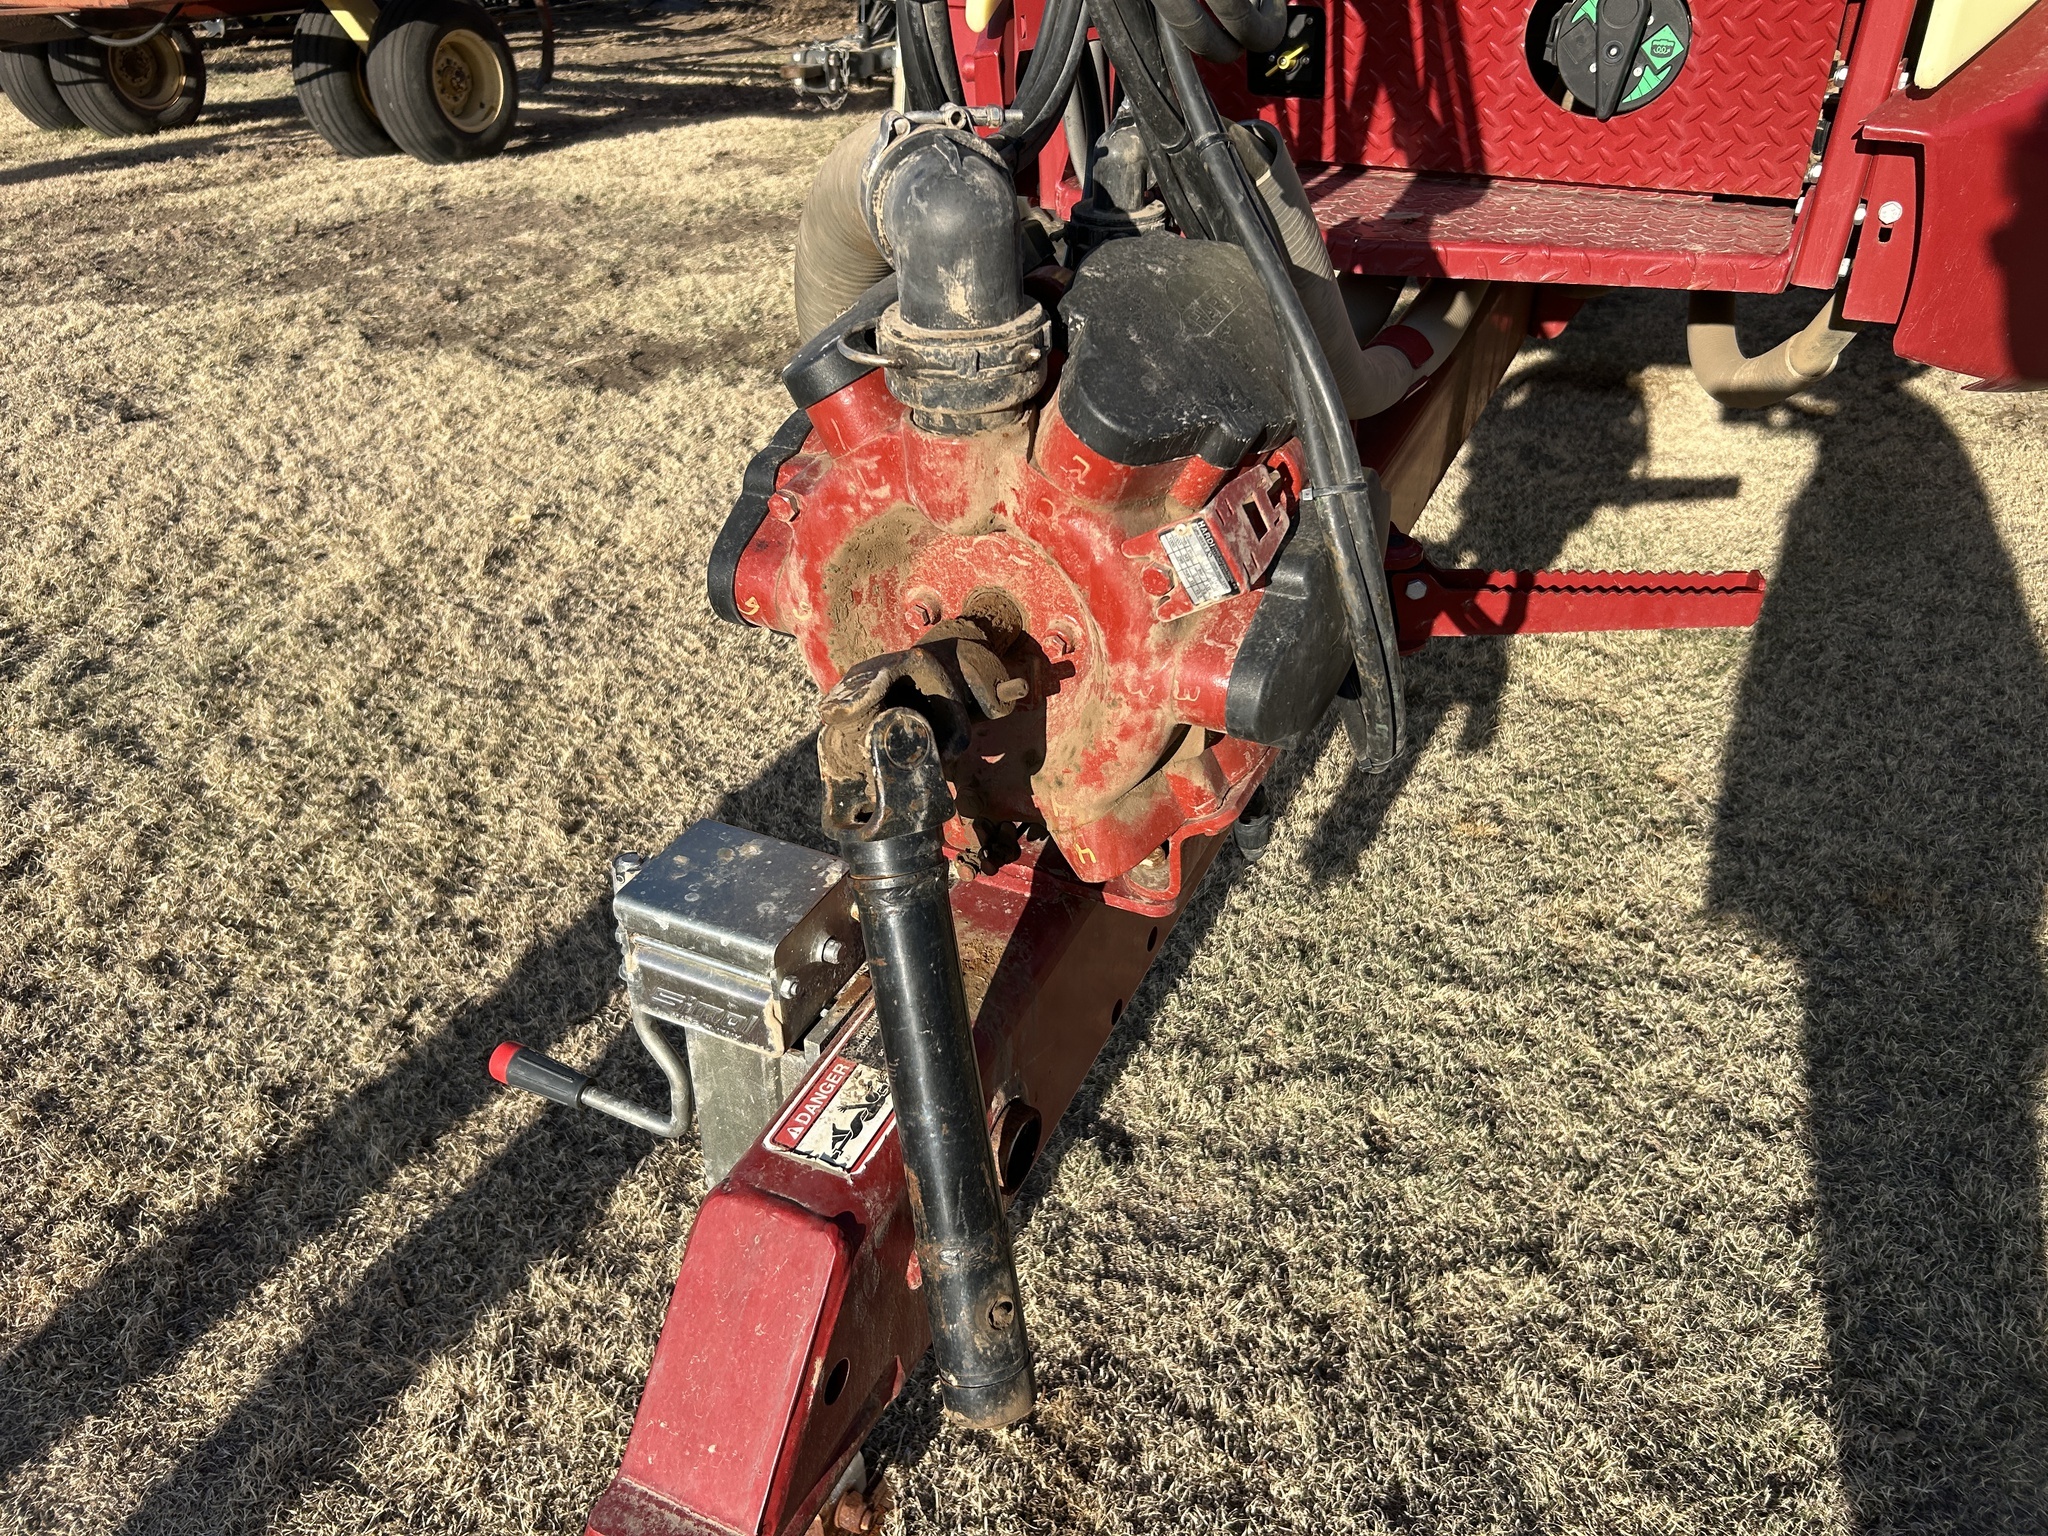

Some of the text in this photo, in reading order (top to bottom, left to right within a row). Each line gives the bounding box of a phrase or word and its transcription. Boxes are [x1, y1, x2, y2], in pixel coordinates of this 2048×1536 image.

[1197, 520, 1216, 548] HARDI
[1074, 843, 1097, 865] 4
[857, 1025, 880, 1053] CONTACT
[795, 1063, 851, 1125] DANGER
